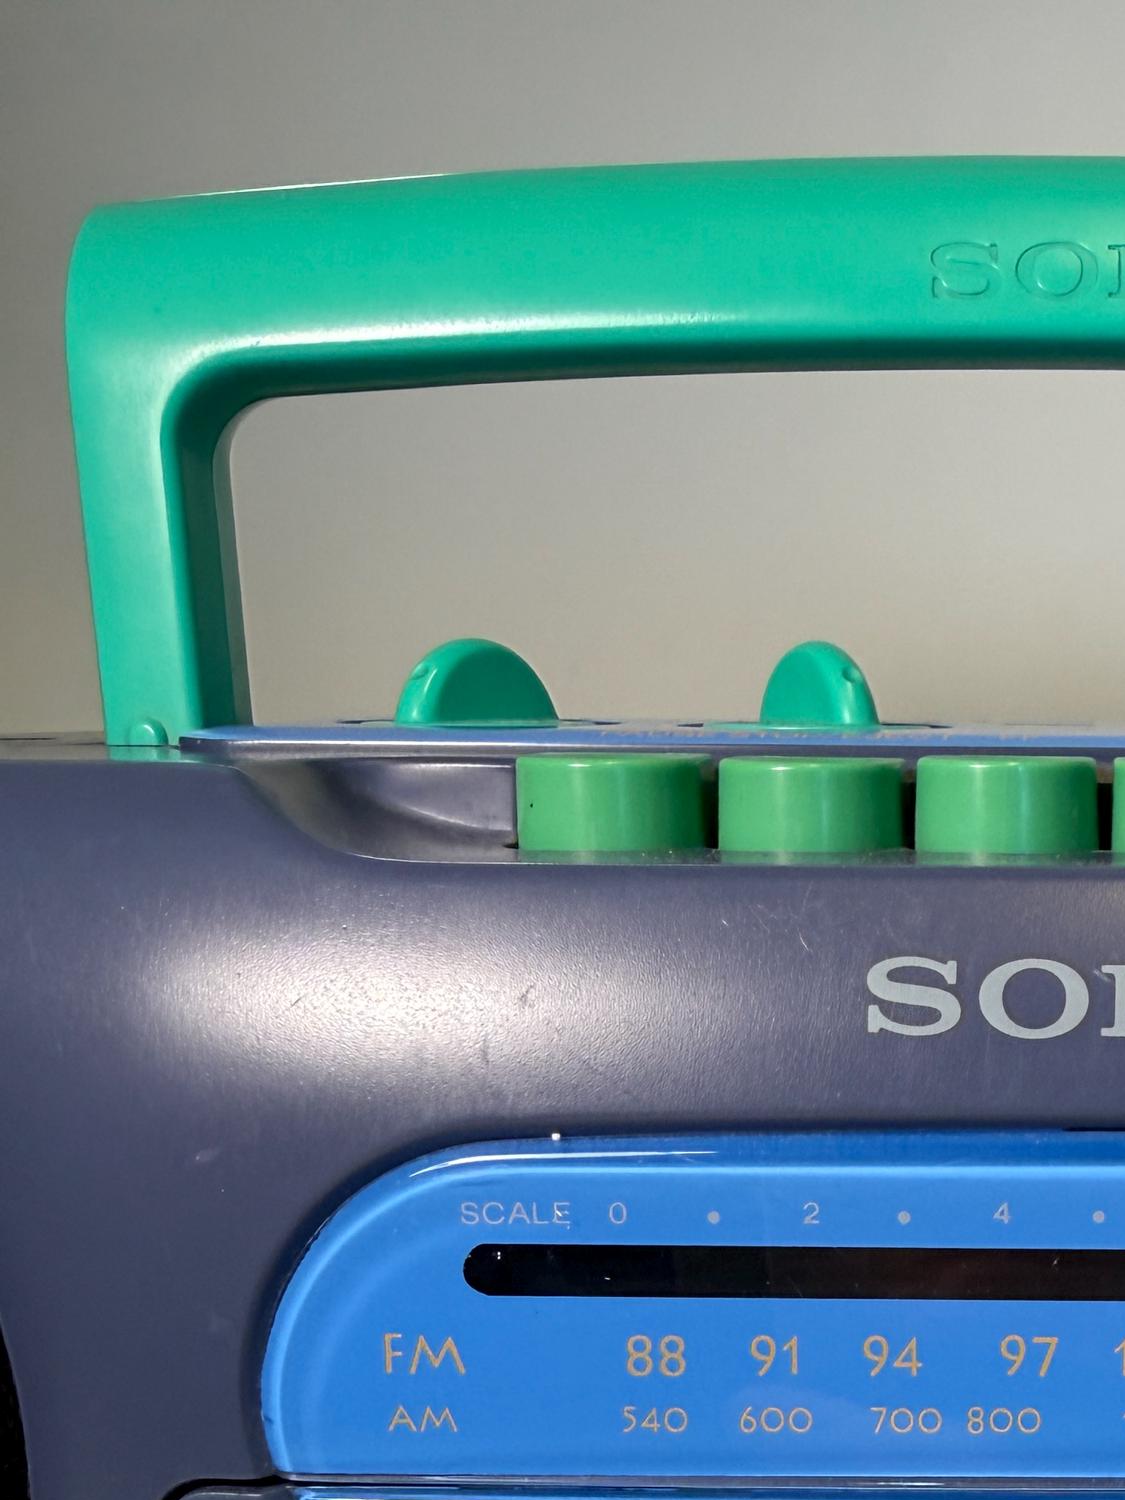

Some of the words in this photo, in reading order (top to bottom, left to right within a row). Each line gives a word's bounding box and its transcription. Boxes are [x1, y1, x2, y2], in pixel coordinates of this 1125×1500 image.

[460, 1201, 571, 1225] SCALE
[608, 1201, 628, 1225] 0
[803, 1201, 820, 1225] 2
[992, 1201, 1012, 1225] 4
[382, 1332, 467, 1377] FM
[625, 1333, 687, 1378] 88
[749, 1334, 800, 1377] 91
[862, 1334, 924, 1378] 94
[998, 1334, 1060, 1378] 97
[387, 1405, 459, 1434] AM
[621, 1405, 689, 1435] 540
[739, 1405, 814, 1435] 600
[869, 1406, 943, 1435] 700
[965, 1406, 1043, 1435] 800
